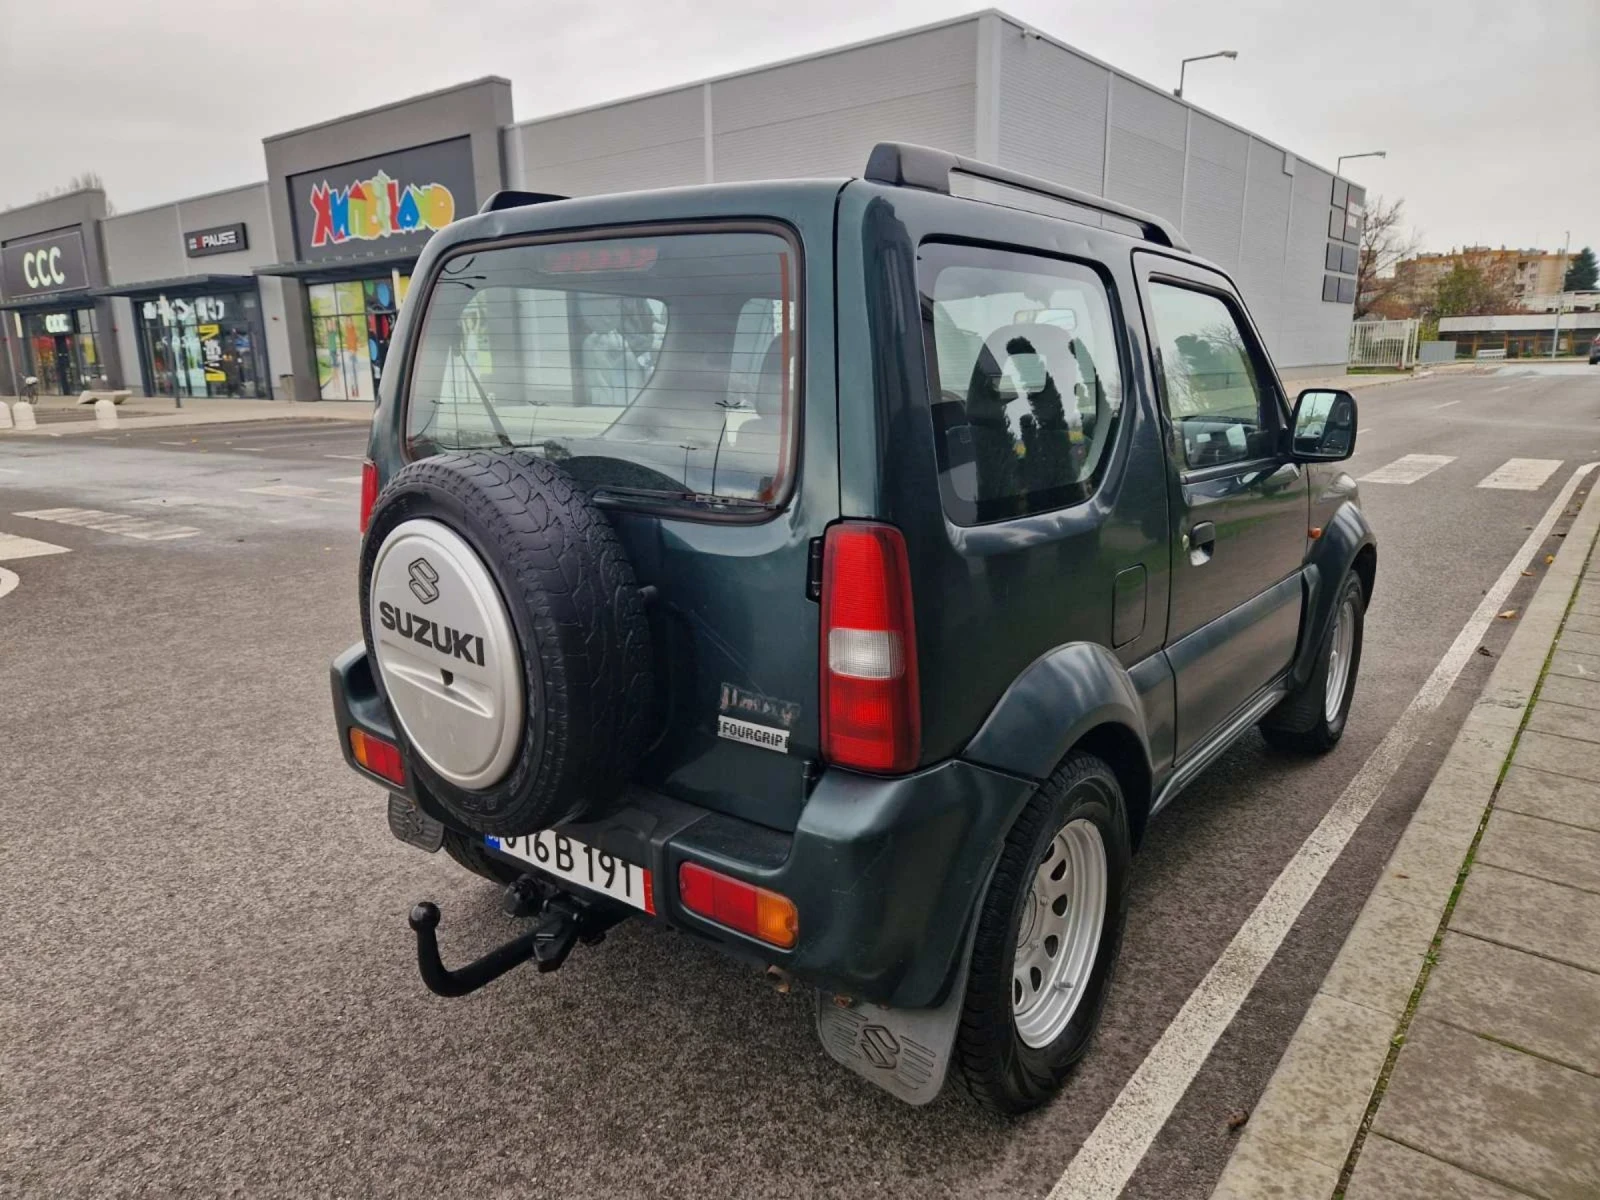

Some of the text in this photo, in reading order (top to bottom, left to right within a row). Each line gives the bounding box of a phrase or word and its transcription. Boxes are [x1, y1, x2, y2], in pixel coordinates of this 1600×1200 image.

[24, 246, 65, 289] CCC
[379, 601, 485, 667] SUZUKI
[722, 721, 784, 747] FOURGRIP
[583, 846, 631, 897] 191
